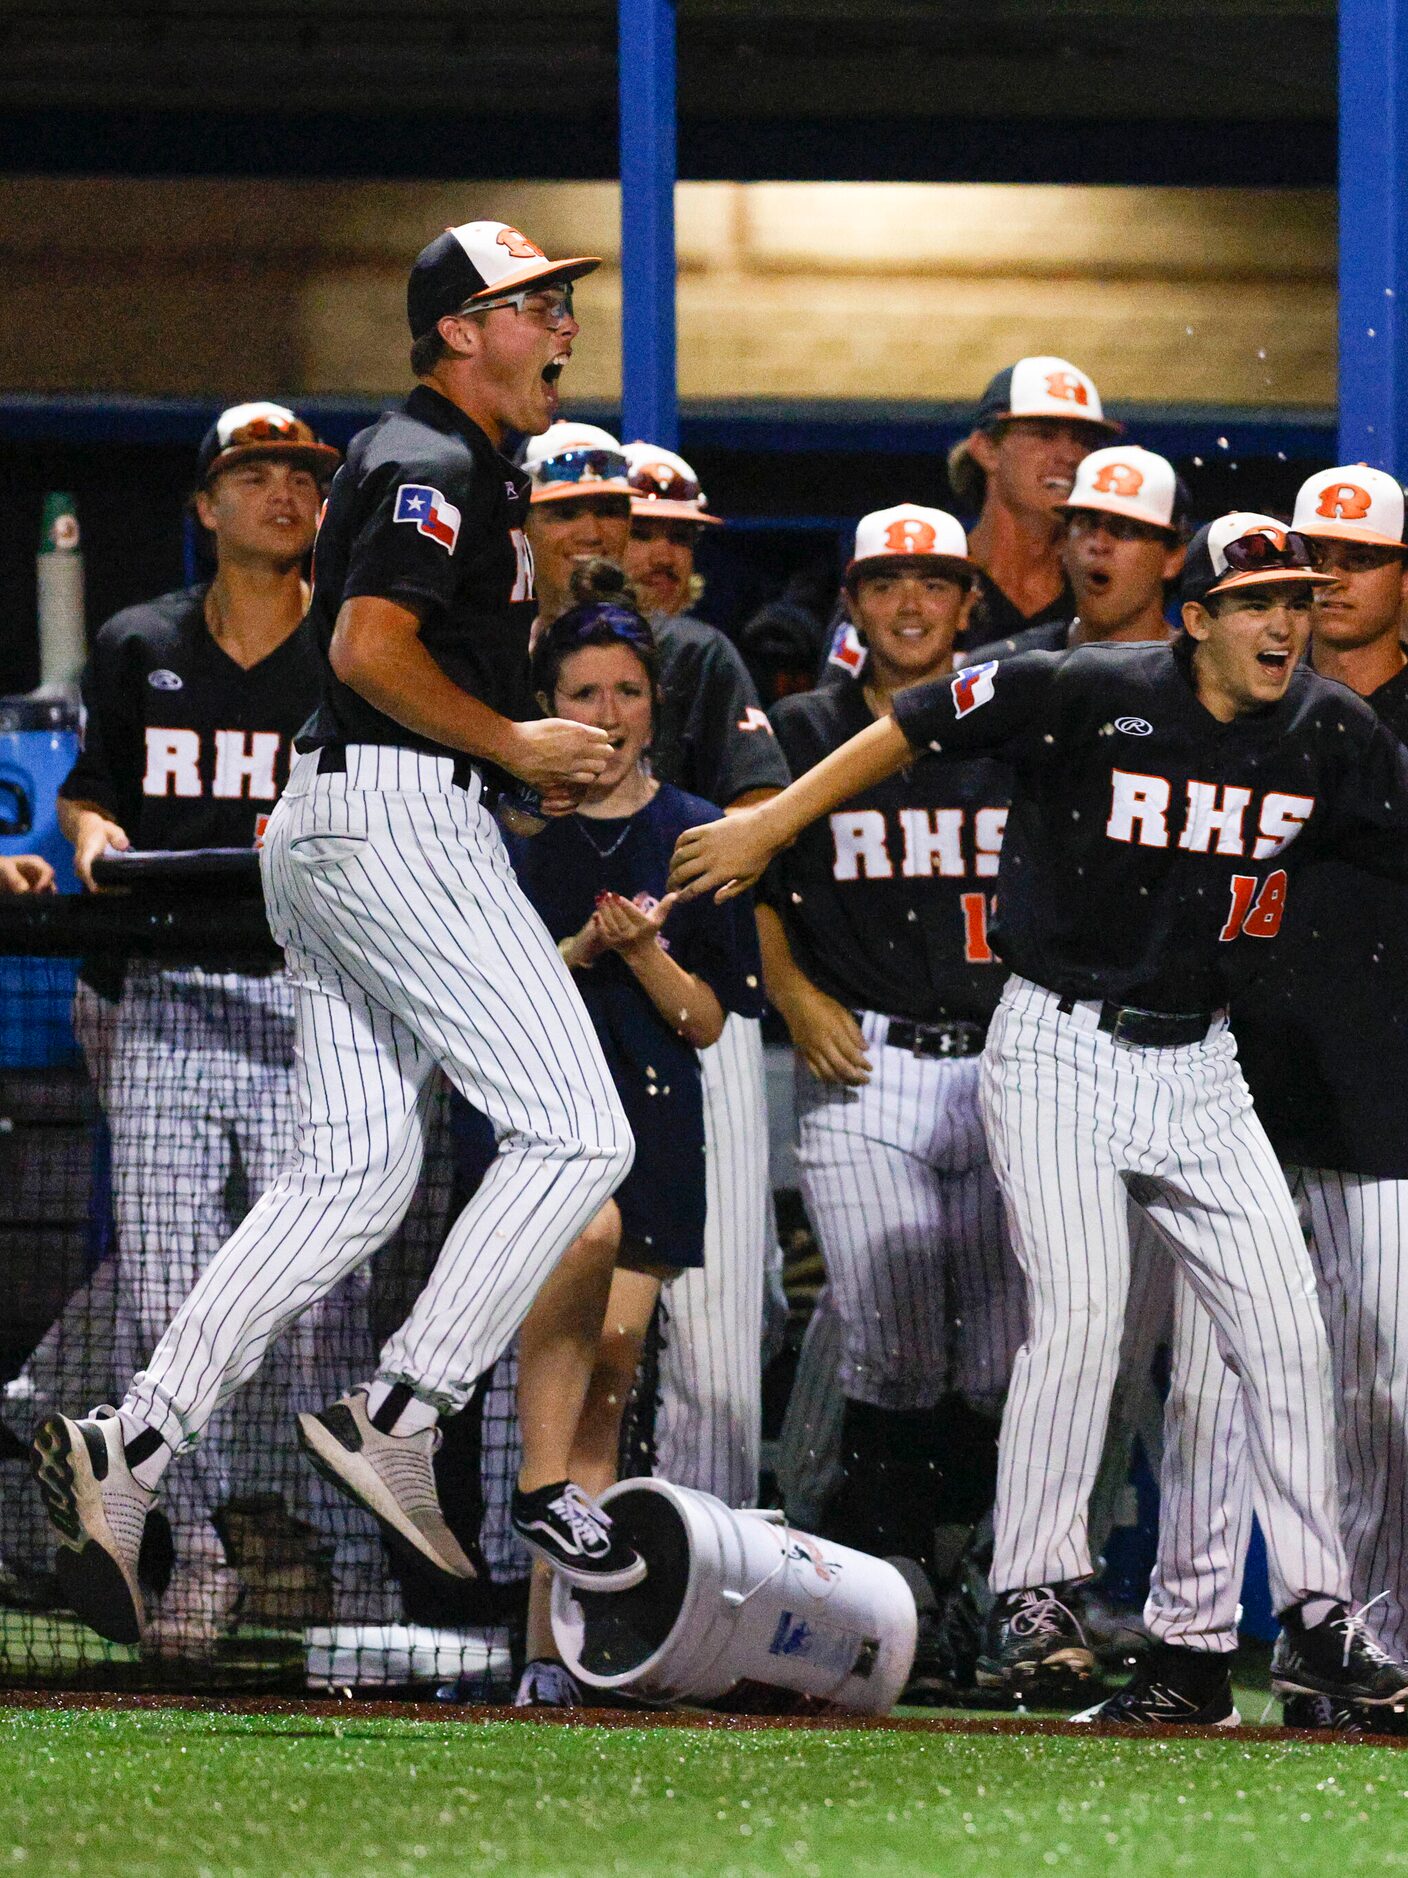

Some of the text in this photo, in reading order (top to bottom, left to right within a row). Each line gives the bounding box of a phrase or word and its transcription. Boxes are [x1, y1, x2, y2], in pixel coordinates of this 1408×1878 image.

[1044, 371, 1088, 406] R
[1092, 463, 1143, 497] R
[1315, 483, 1372, 519] R
[884, 519, 936, 553] R
[142, 726, 302, 799] RH
[1106, 767, 1315, 860] RHS
[960, 892, 1002, 965] 1
[1219, 869, 1287, 942] 18
